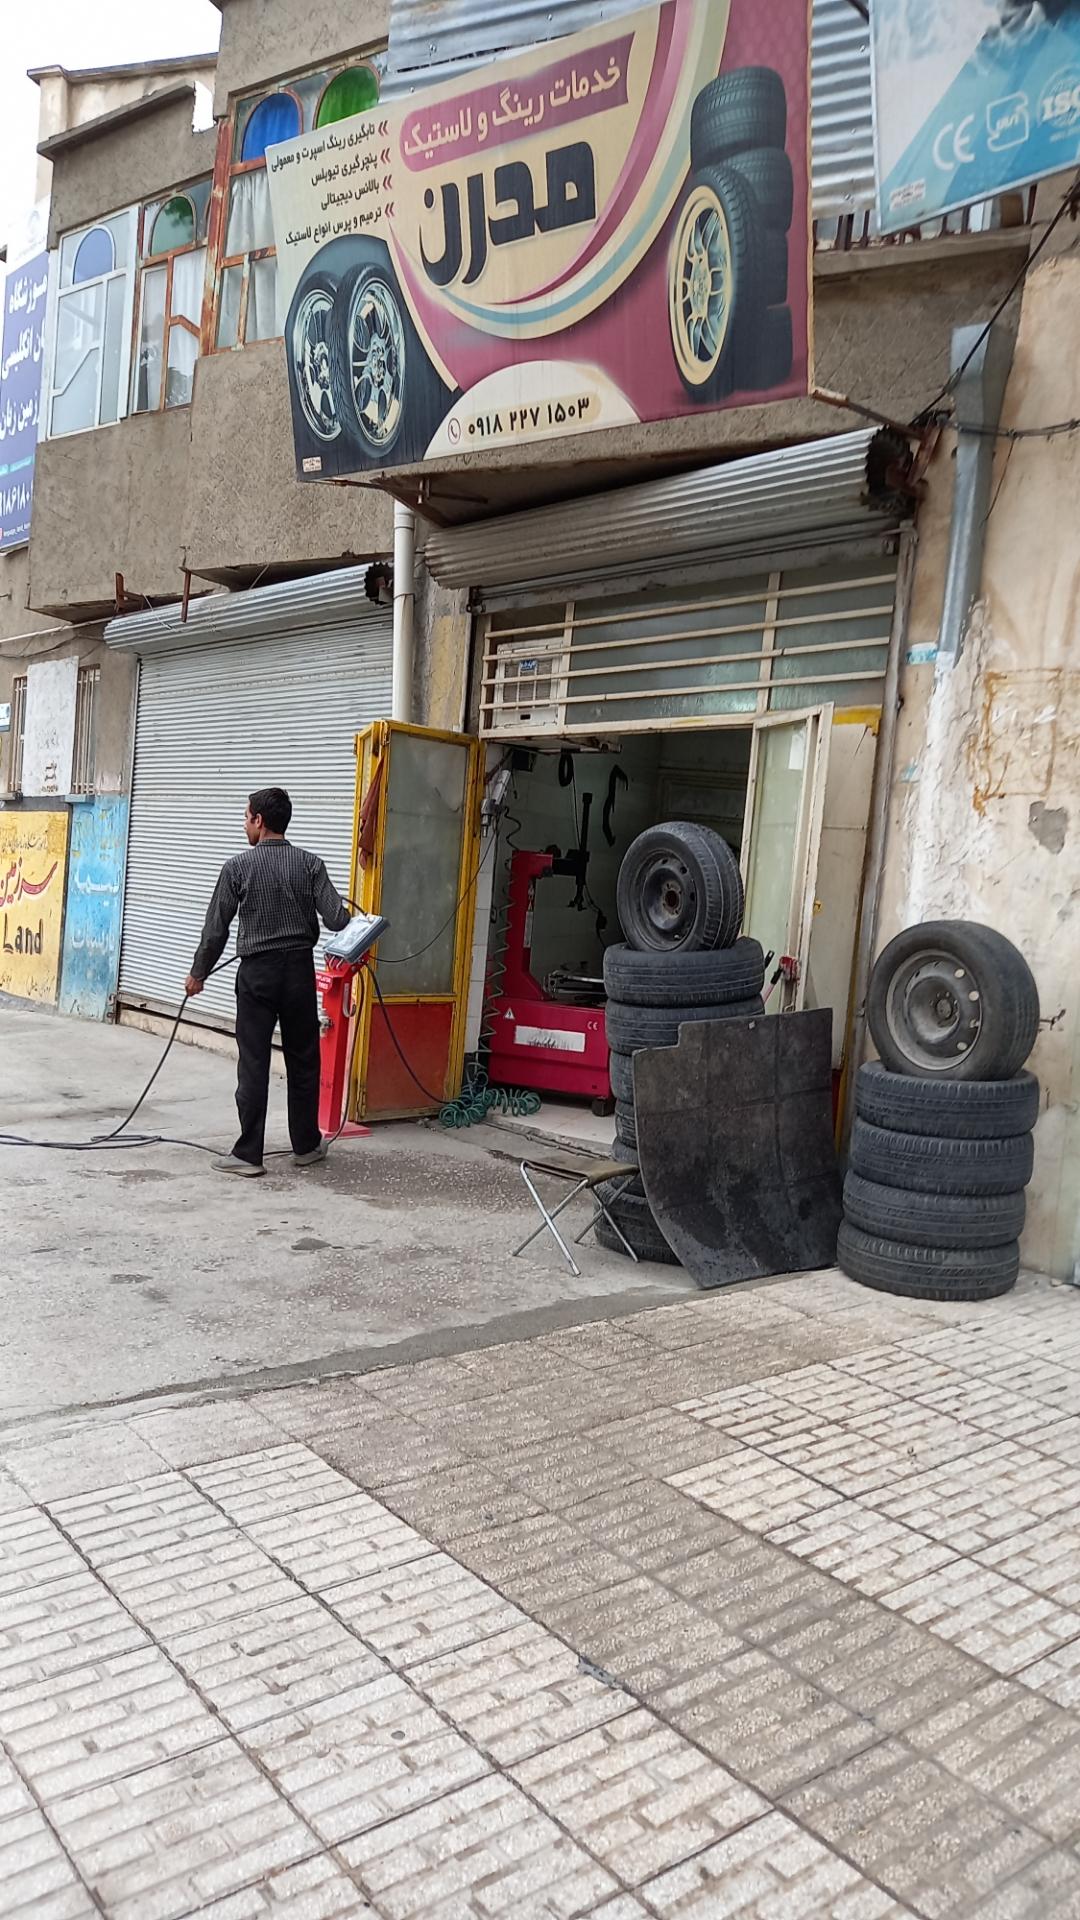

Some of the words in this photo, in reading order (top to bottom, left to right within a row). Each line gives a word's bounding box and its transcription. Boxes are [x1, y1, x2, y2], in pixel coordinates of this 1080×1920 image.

[549, 56, 621, 107] خدمات
[492, 87, 544, 127] رینگ
[348, 122, 375, 147] تابگیری
[403, 107, 472, 159] لاستیک
[477, 112, 488, 142] و
[302, 140, 325, 160] اسپرت
[326, 135, 346, 150] رینگ
[932, 113, 975, 171] CE
[271, 153, 295, 173] معمولی
[296, 152, 301, 164] و
[311, 164, 340, 186] تیوبلس
[321, 189, 353, 211] دیجیتالی
[354, 179, 380, 200] بالانس
[353, 216, 358, 229] و
[359, 206, 382, 228] ترمیم
[419, 141, 597, 286] مدرن
[285, 226, 312, 247] لاستیک
[313, 221, 331, 244] انواع
[333, 220, 352, 236] پرس
[9, 273, 48, 314] موزشگاه
[2, 324, 33, 380] انگلیسی
[468, 413, 503, 436] ۰۹۱۸
[510, 407, 540, 431] ۲۲۷
[548, 397, 590, 424] ۱۵۰۳
[3, 912, 43, 955] Land
[587, 1021, 598, 1031] CE
